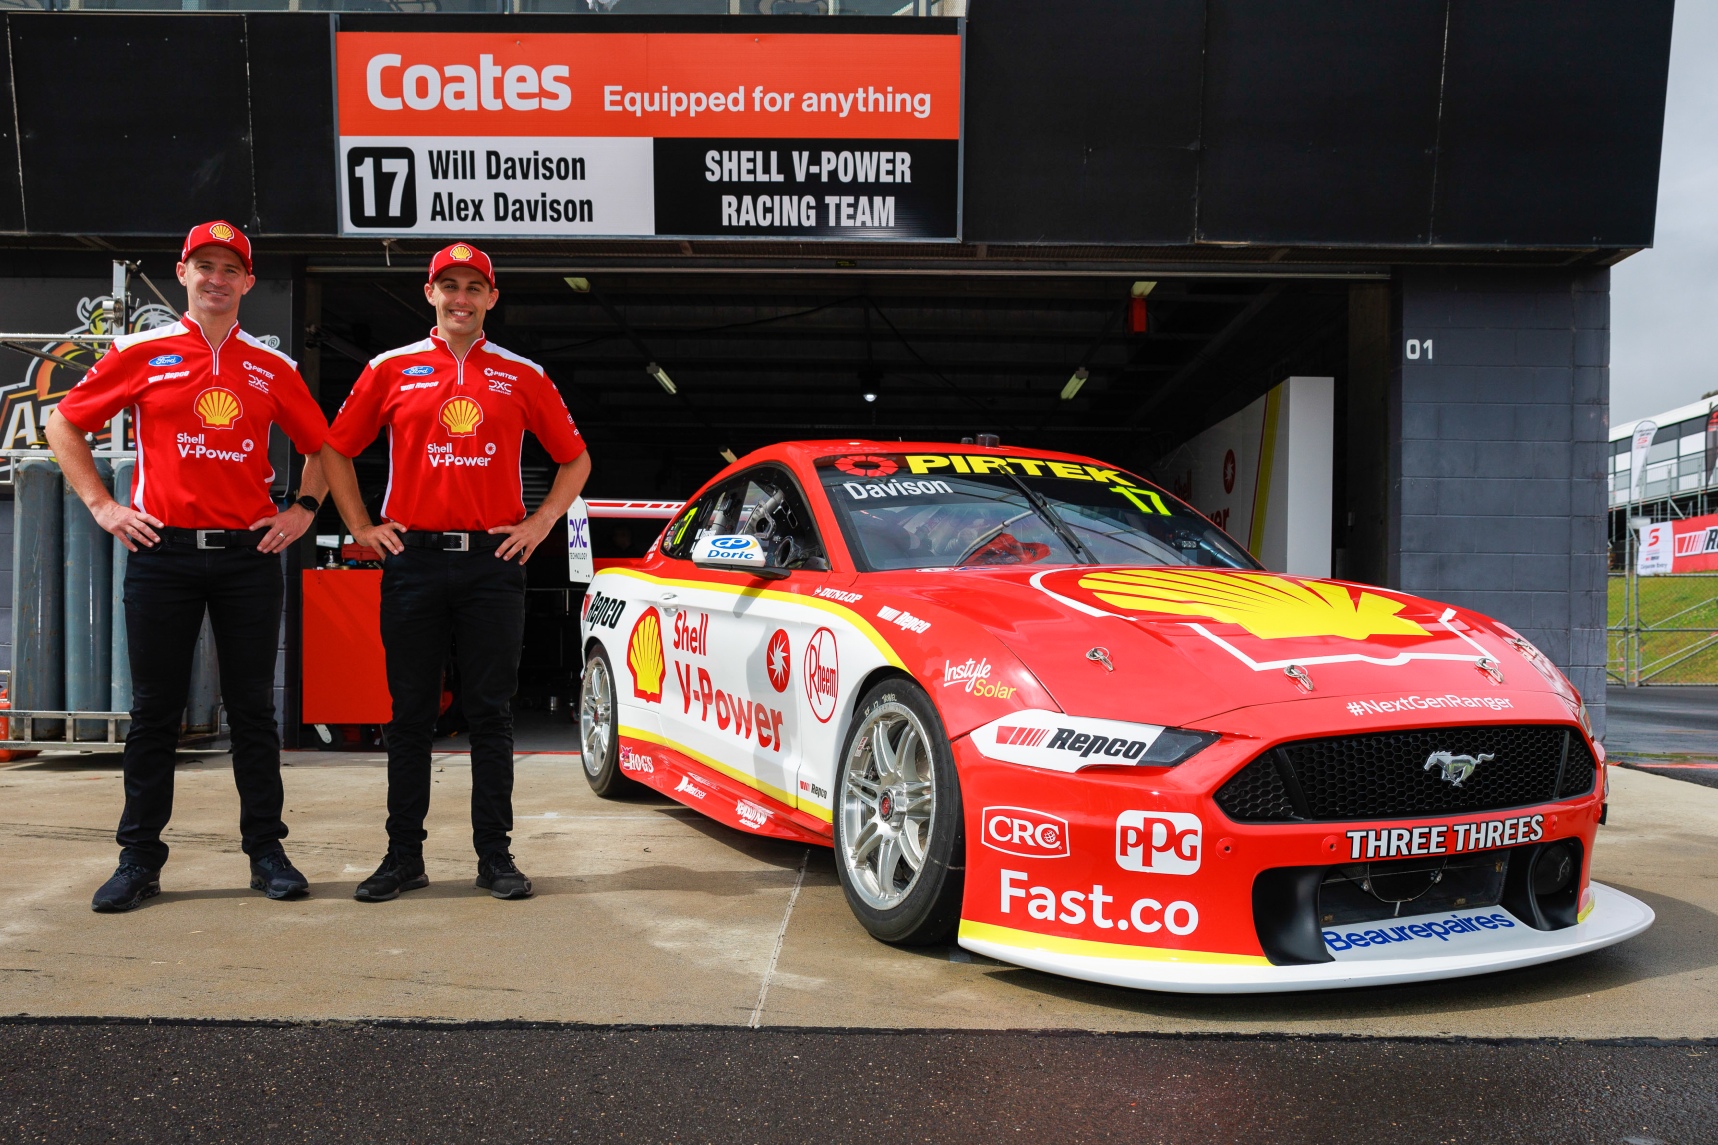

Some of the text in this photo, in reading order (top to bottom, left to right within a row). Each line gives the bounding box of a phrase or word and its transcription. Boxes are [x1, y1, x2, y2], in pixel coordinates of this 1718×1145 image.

[366, 53, 572, 112] Coates
[604, 86, 933, 118] Equipped for anything
[428, 150, 586, 181] Will Davison
[706, 150, 912, 183] SHELL V-POWER
[354, 158, 409, 217] 17
[430, 192, 594, 223] Alex Davison
[722, 195, 895, 228] RACING TEAM
[155, 356, 176, 365] Ford
[1406, 339, 1434, 360] 01
[164, 371, 190, 380] Repco
[251, 364, 275, 380] PIRTEK
[177, 433, 204, 444] Shell
[177, 444, 247, 462] V-Power
[427, 443, 452, 453] Shell
[429, 454, 491, 467] V-Power
[904, 455, 1137, 487] PIRTEK
[843, 479, 953, 500] Davison
[1109, 486, 1172, 516] 17
[707, 550, 754, 559] Doric
[820, 587, 863, 603] DUNLOP
[673, 609, 709, 656] Shell
[894, 610, 932, 634] Repco
[809, 631, 836, 706] Rheem
[944, 658, 992, 693] Instyle
[974, 678, 1017, 700] Solar
[674, 660, 784, 753] V-Power
[1346, 694, 1514, 717] #NextGenRanger
[1046, 728, 1147, 760] Repco
[629, 753, 654, 773] HOGS
[811, 783, 827, 799] Repco
[988, 815, 1060, 849] CRC
[1346, 814, 1544, 860] THREE THREES
[1000, 869, 1199, 936] Fast.co
[1324, 913, 1515, 952] Beaurepaires
